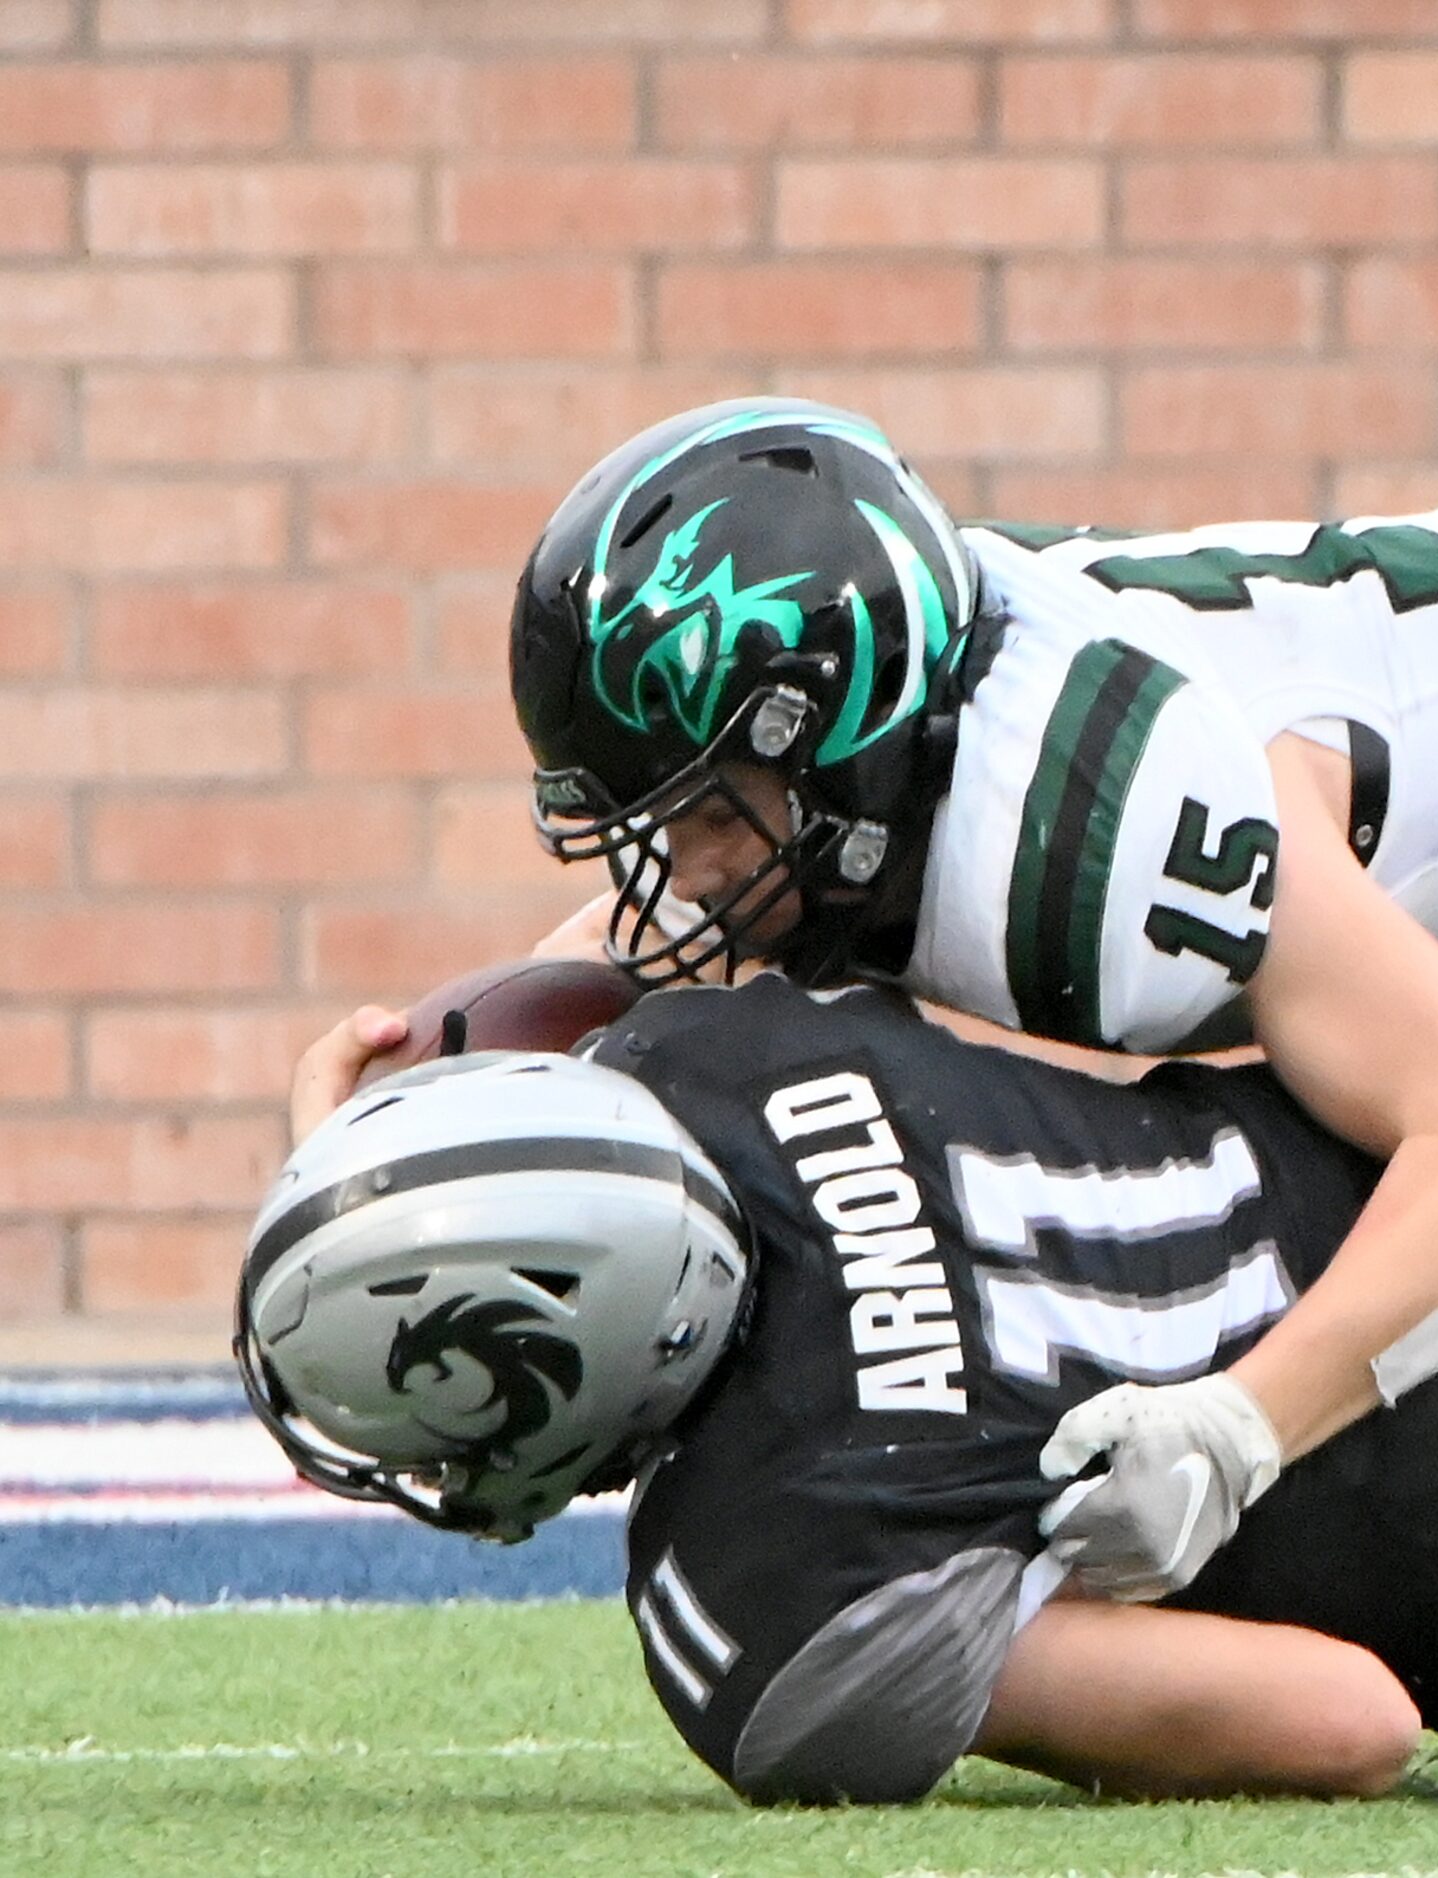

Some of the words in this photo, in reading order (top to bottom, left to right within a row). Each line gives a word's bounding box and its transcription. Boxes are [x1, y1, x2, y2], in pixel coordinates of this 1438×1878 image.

[1143, 795, 1280, 985] 15
[764, 1071, 968, 1414] ARNOLD
[944, 1125, 1298, 1388] 11
[637, 1543, 744, 1712] 11
